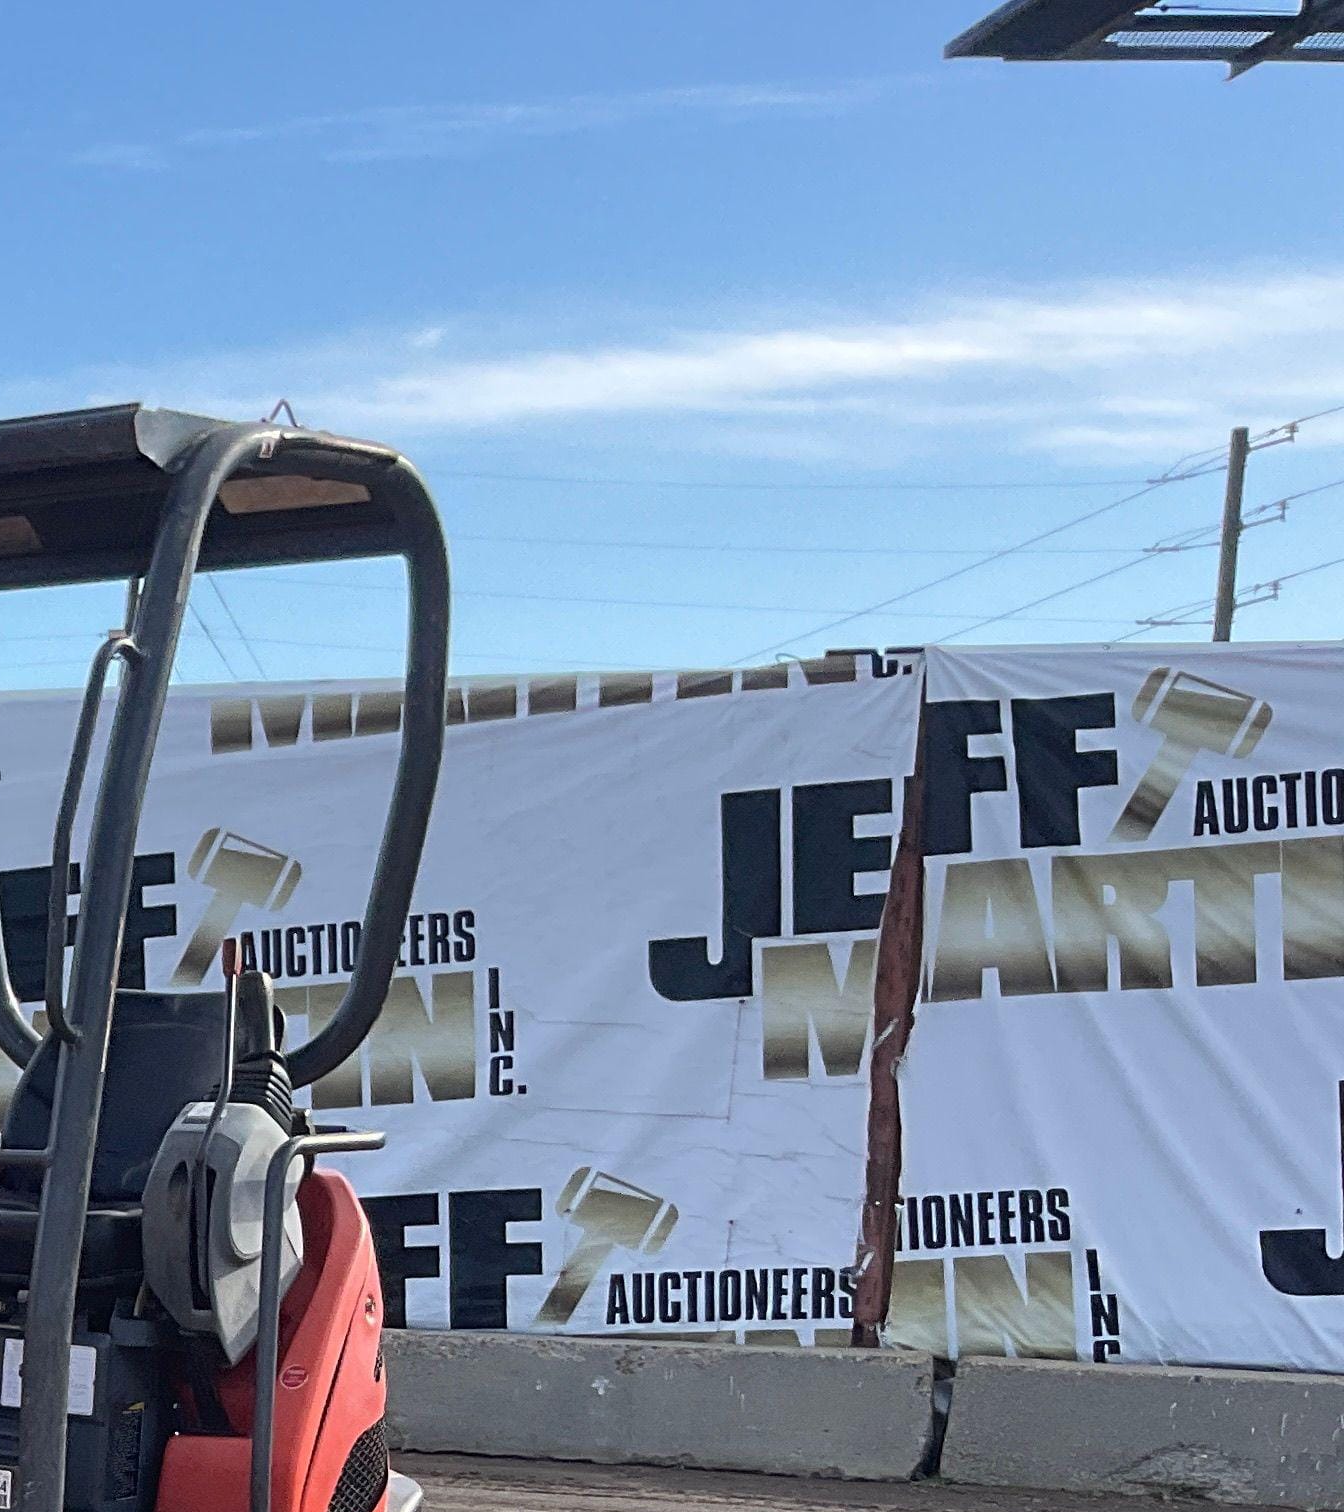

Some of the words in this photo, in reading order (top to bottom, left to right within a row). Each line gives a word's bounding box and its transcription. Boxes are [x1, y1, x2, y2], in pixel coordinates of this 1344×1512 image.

[1193, 768, 1344, 837] AUCTIO
[648, 692, 1119, 1001] JEFF
[241, 910, 476, 980] AUCTIOERS
[763, 835, 1344, 1080] MARTI
[606, 1266, 857, 1325] AUCTIONEERS
